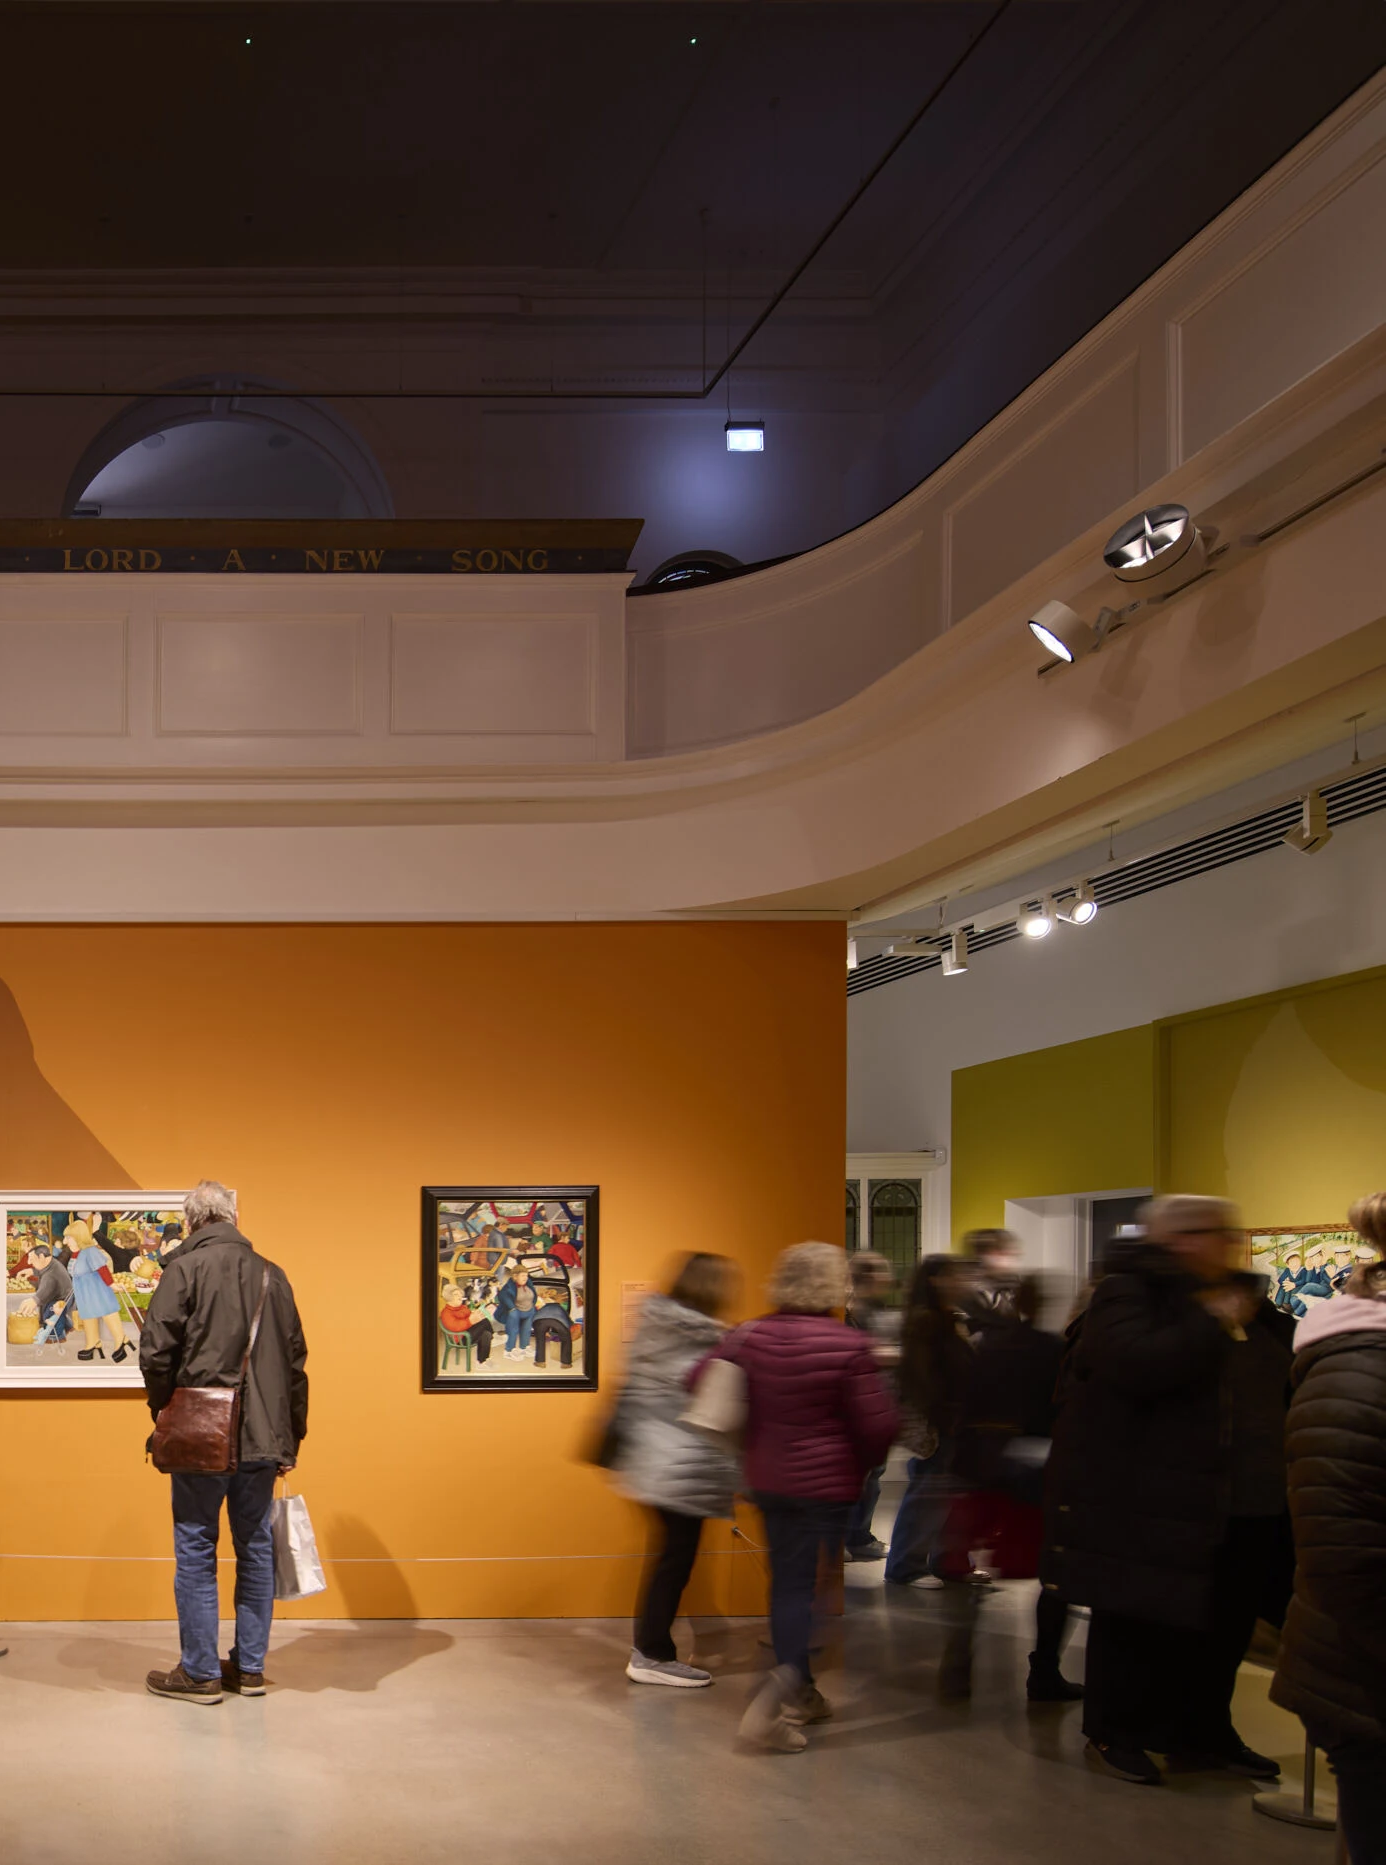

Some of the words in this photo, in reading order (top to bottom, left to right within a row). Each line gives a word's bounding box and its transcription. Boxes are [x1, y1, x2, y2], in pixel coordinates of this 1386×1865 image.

[63, 548, 162, 571] LORD
[222, 548, 246, 571] A
[305, 549, 385, 571] NEW
[451, 549, 549, 572] SONG
